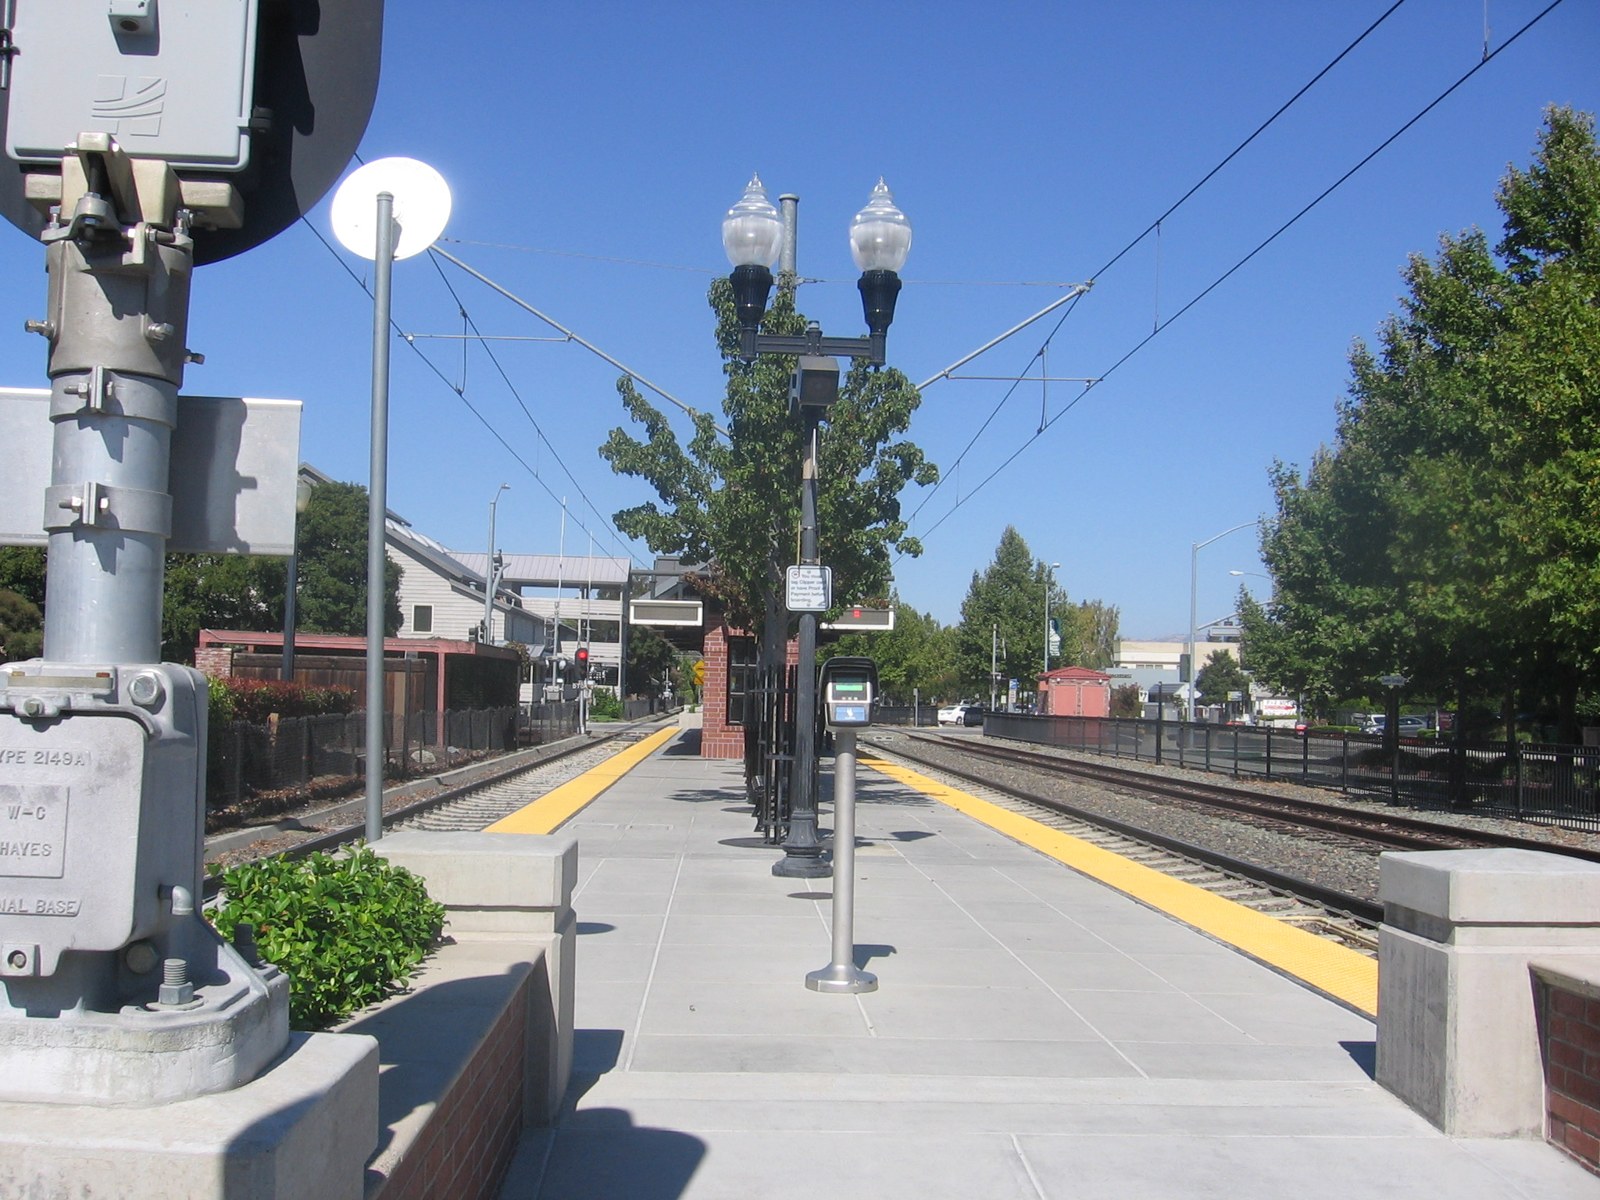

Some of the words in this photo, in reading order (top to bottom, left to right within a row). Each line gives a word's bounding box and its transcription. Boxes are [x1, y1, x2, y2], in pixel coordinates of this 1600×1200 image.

[33, 751, 86, 766] 2149A
[0, 842, 52, 857] HAYES
[35, 899, 77, 915] BASE
